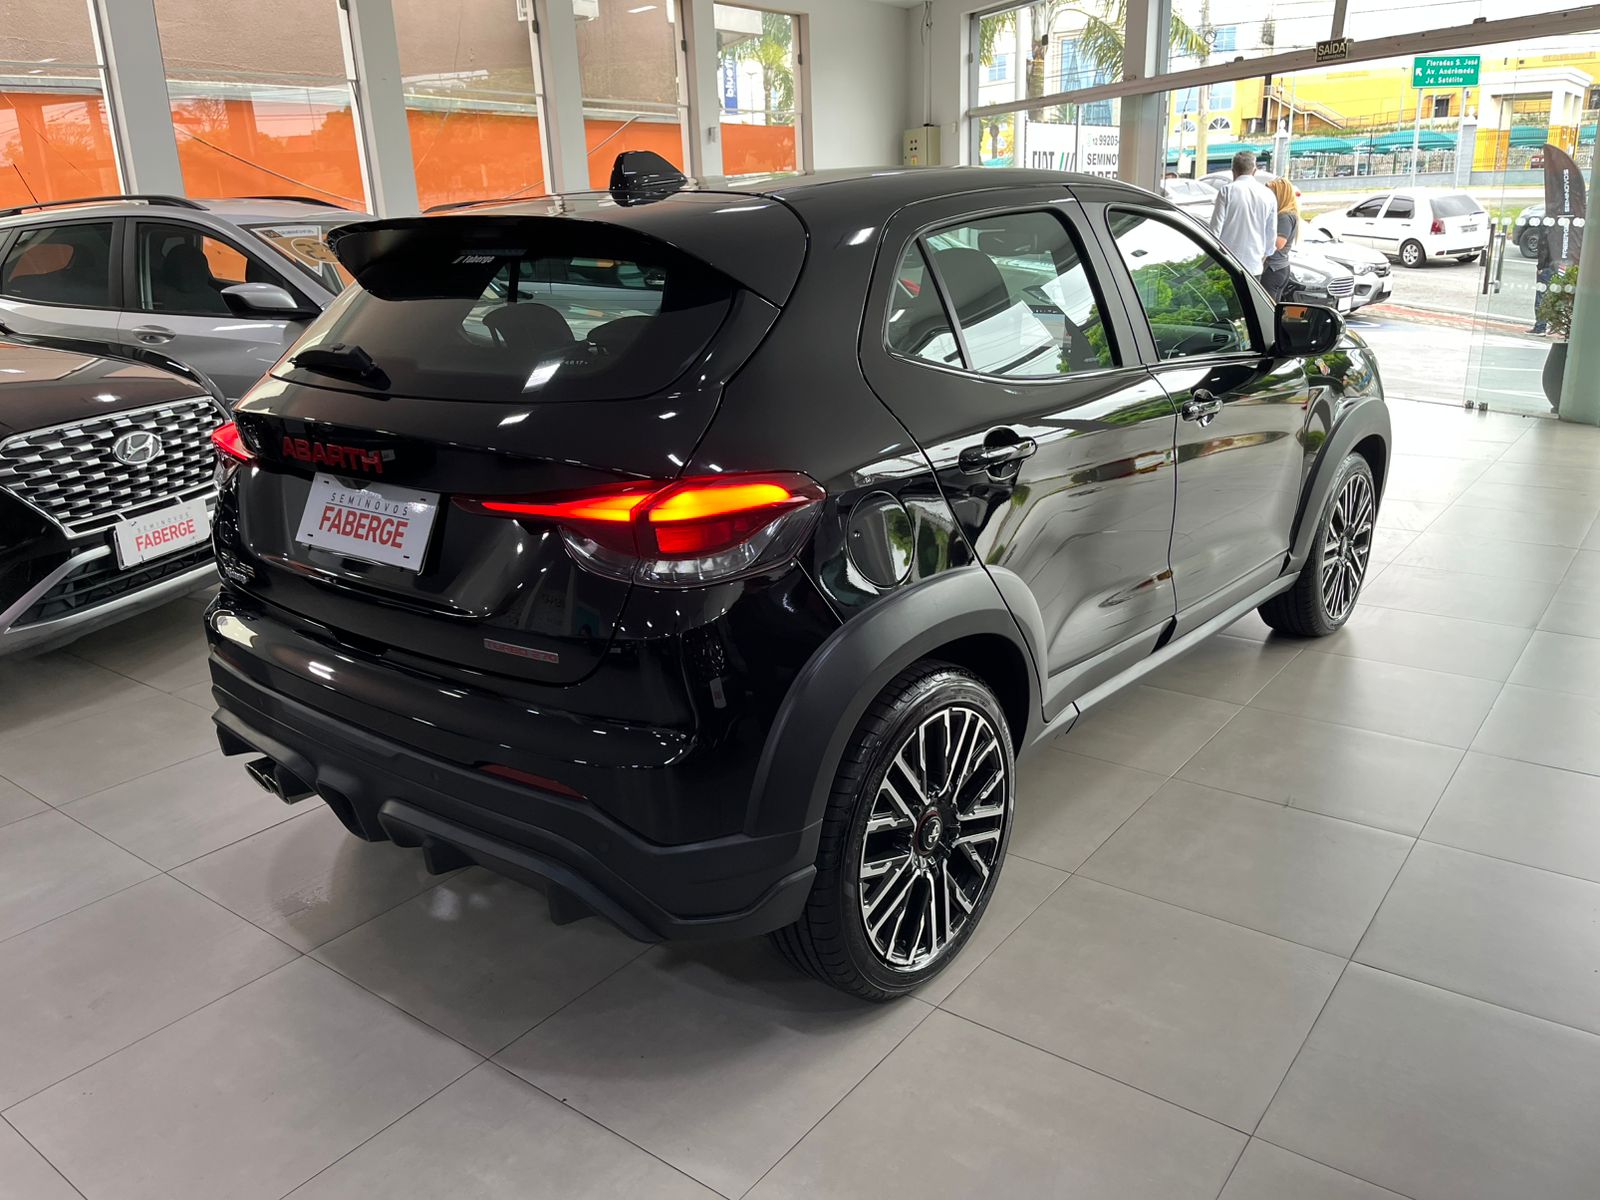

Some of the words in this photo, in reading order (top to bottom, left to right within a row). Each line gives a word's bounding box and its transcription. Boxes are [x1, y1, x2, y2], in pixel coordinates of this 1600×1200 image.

[1318, 41, 1345, 56] SAÍDA
[1464, 58, 1478, 66] José
[1087, 153, 1119, 166] SEMINO
[282, 436, 384, 474] ABARTH
[331, 491, 410, 516] SEMINOVOS
[137, 512, 190, 533] SEMINOVOS
[318, 505, 409, 549] FABERGE
[135, 518, 196, 552] FABERGE
